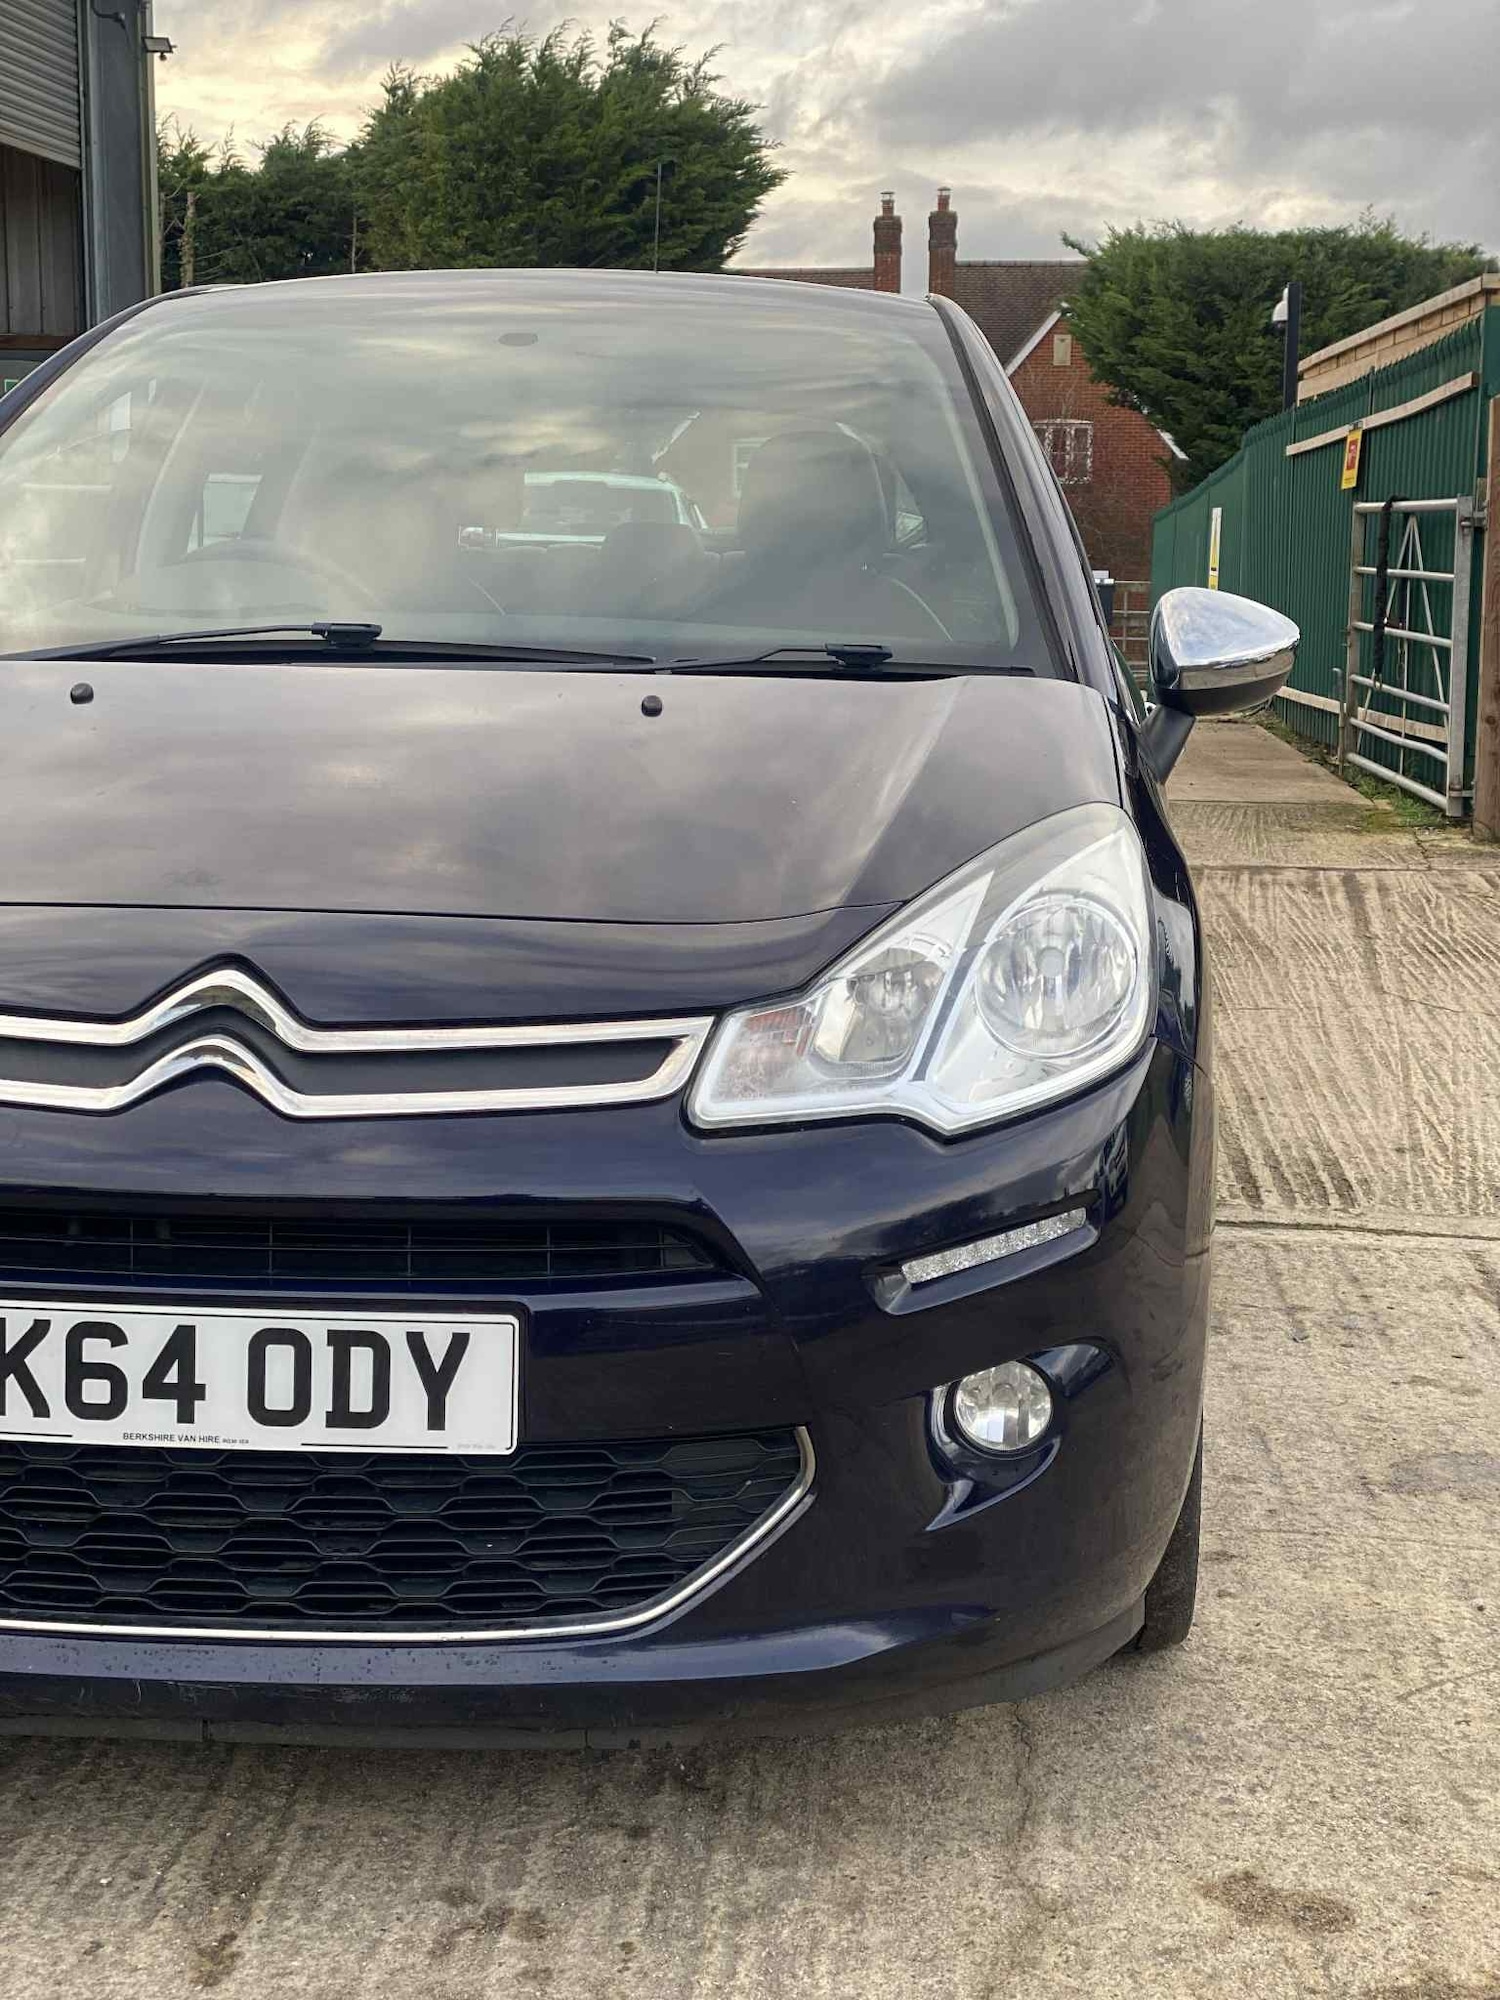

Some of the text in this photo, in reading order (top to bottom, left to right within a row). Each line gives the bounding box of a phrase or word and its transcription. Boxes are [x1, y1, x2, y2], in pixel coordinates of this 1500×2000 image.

[0, 1317, 471, 1431] K64 ODY
[122, 1432, 175, 1442] BERKSHIRE
[177, 1434, 196, 1442] VAN
[198, 1435, 220, 1444] HIRE
